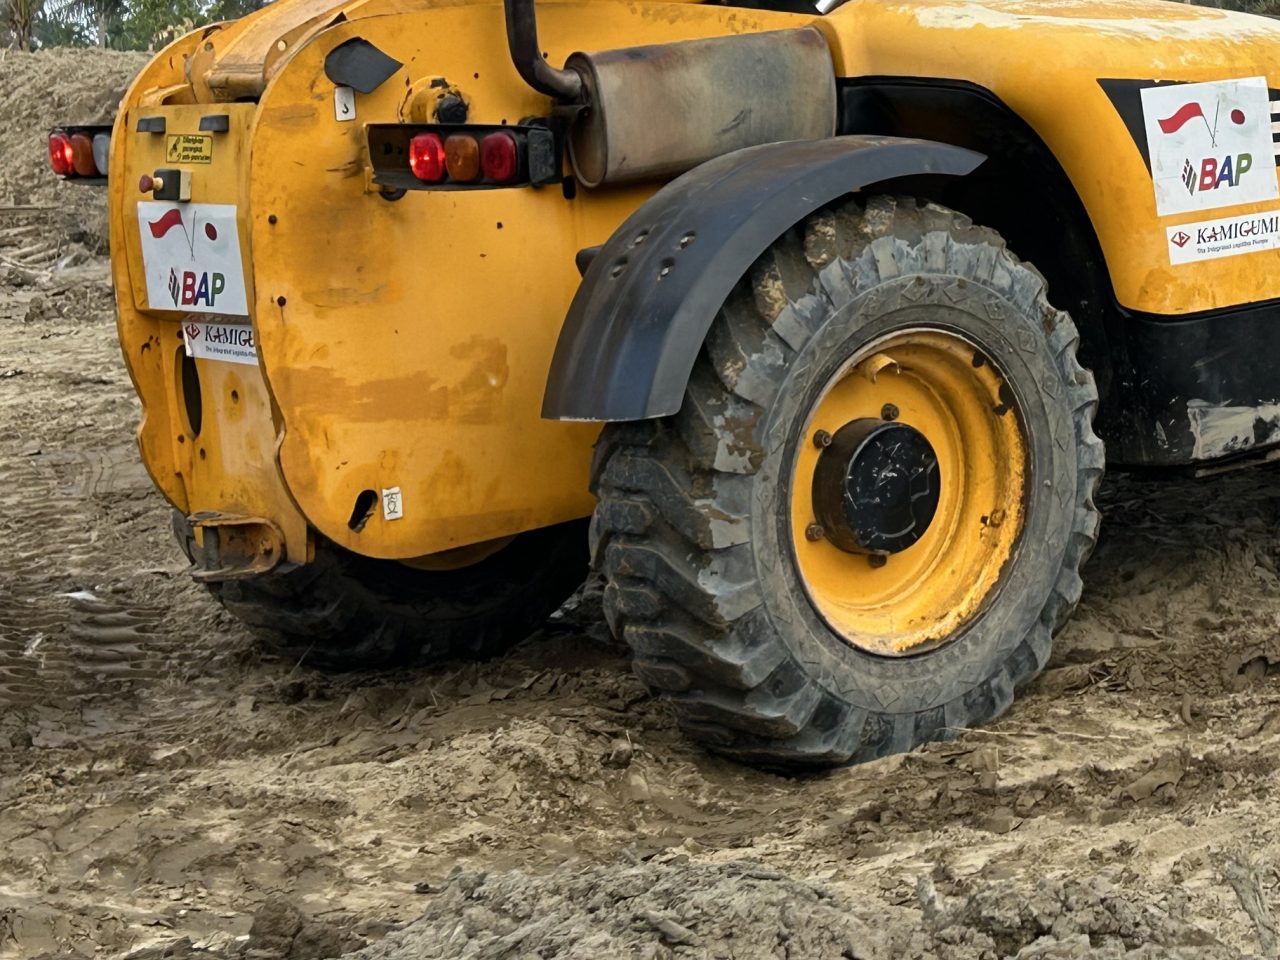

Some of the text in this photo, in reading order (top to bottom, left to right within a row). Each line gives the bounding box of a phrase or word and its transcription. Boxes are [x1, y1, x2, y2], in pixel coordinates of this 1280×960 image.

[1198, 152, 1253, 192] BAP
[1196, 216, 1279, 244] KAMIGUMI
[181, 270, 226, 307] BAP
